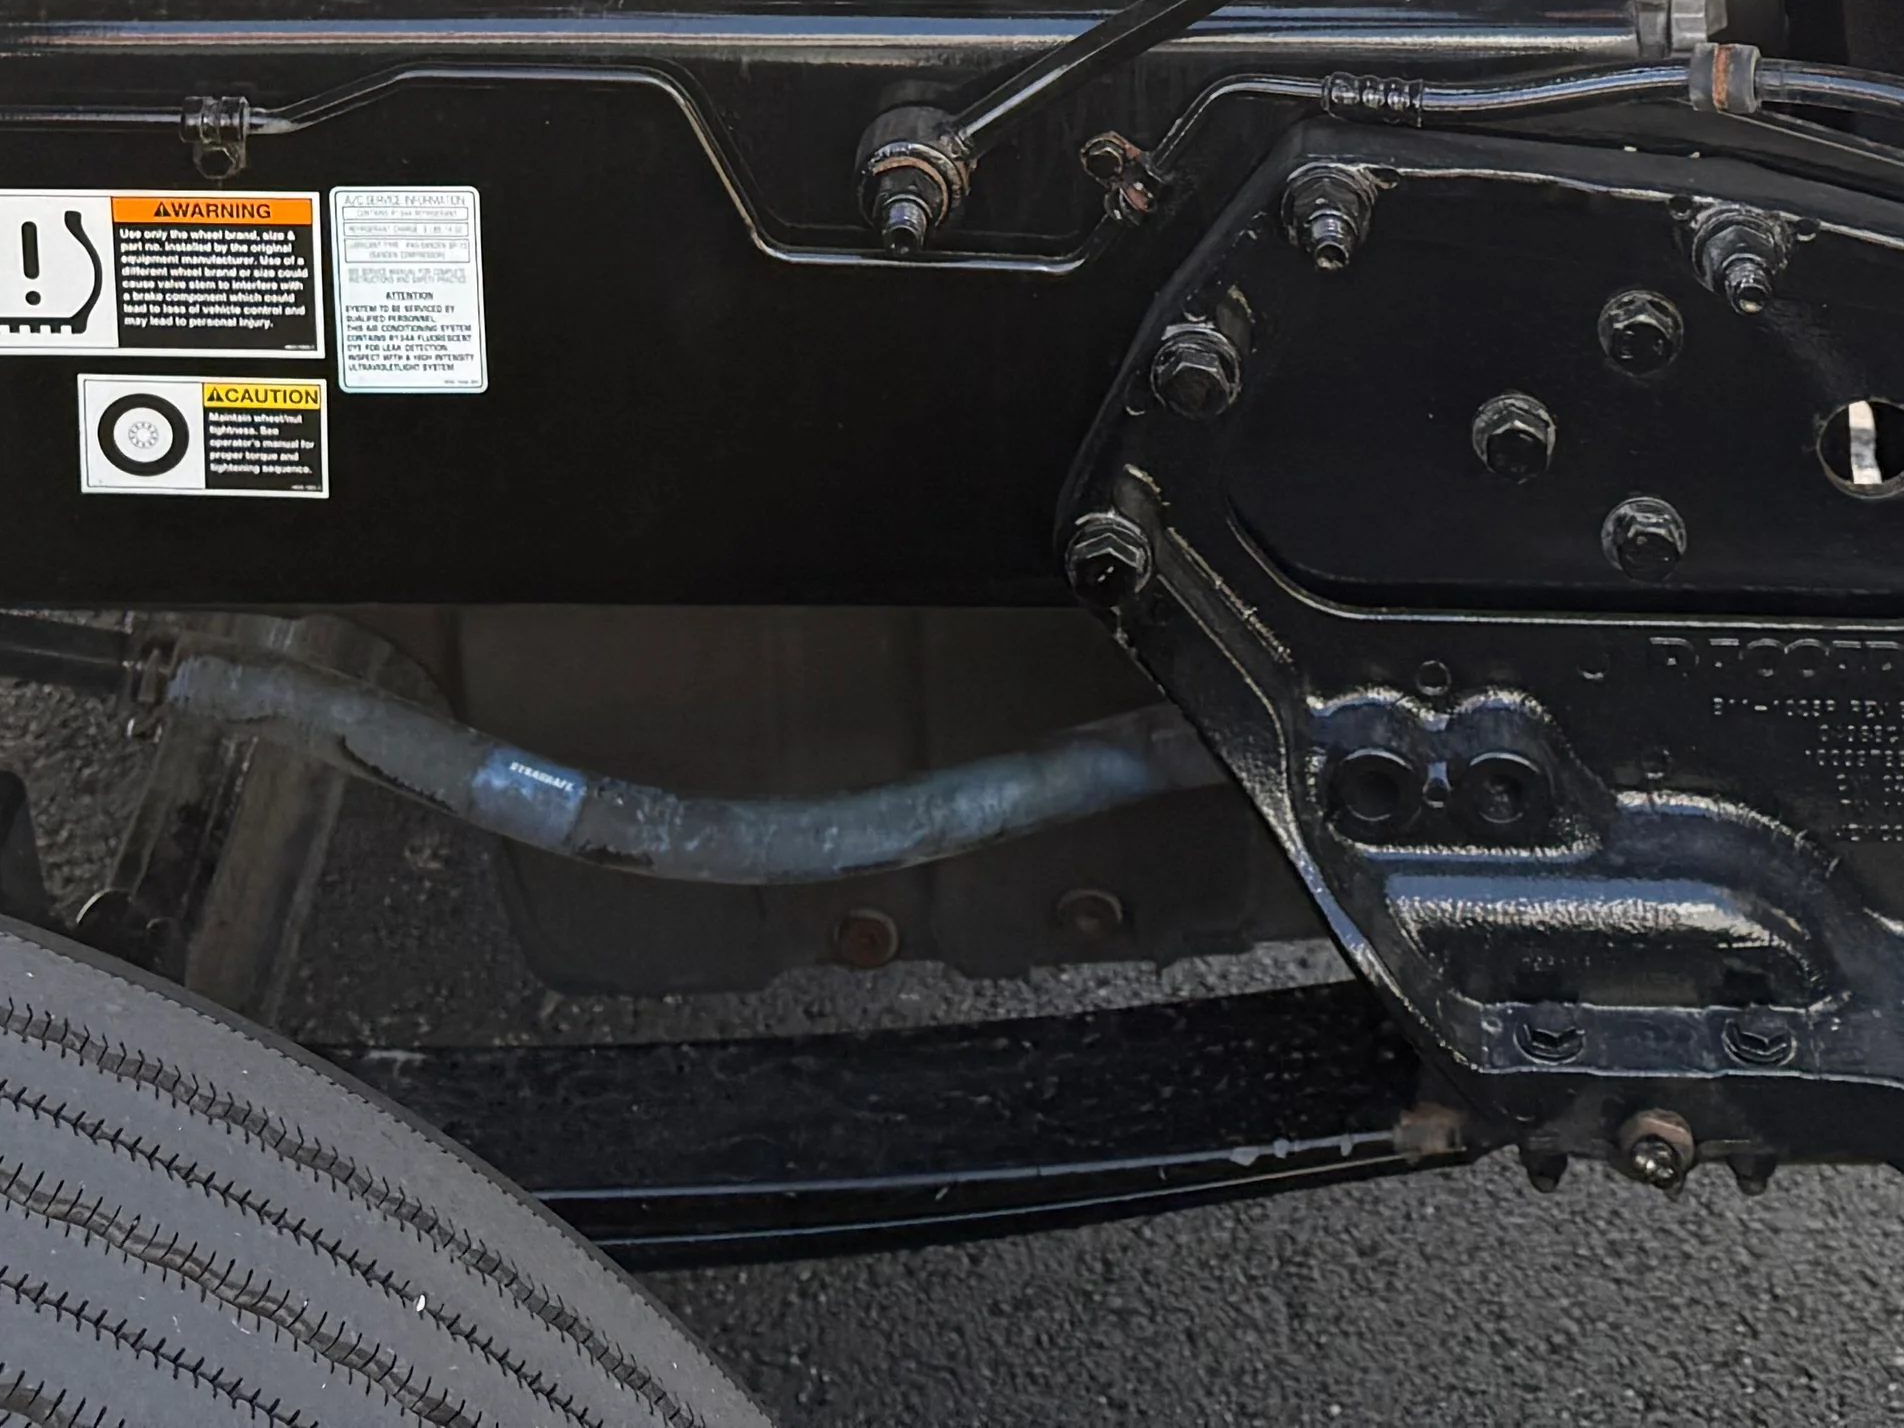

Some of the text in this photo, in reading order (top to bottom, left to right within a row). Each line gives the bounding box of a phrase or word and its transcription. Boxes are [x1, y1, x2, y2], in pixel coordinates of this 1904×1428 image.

[172, 203, 272, 219] WARNING
[287, 231, 295, 241] &
[214, 243, 228, 254] by
[284, 256, 295, 265] of
[297, 257, 305, 266] a
[240, 270, 251, 278] or
[219, 281, 230, 290] to
[123, 293, 130, 301] a
[386, 292, 434, 301] ATTENTION
[150, 305, 160, 314] to
[189, 305, 200, 314] of
[176, 317, 187, 327] to
[225, 388, 318, 405] CAUTION
